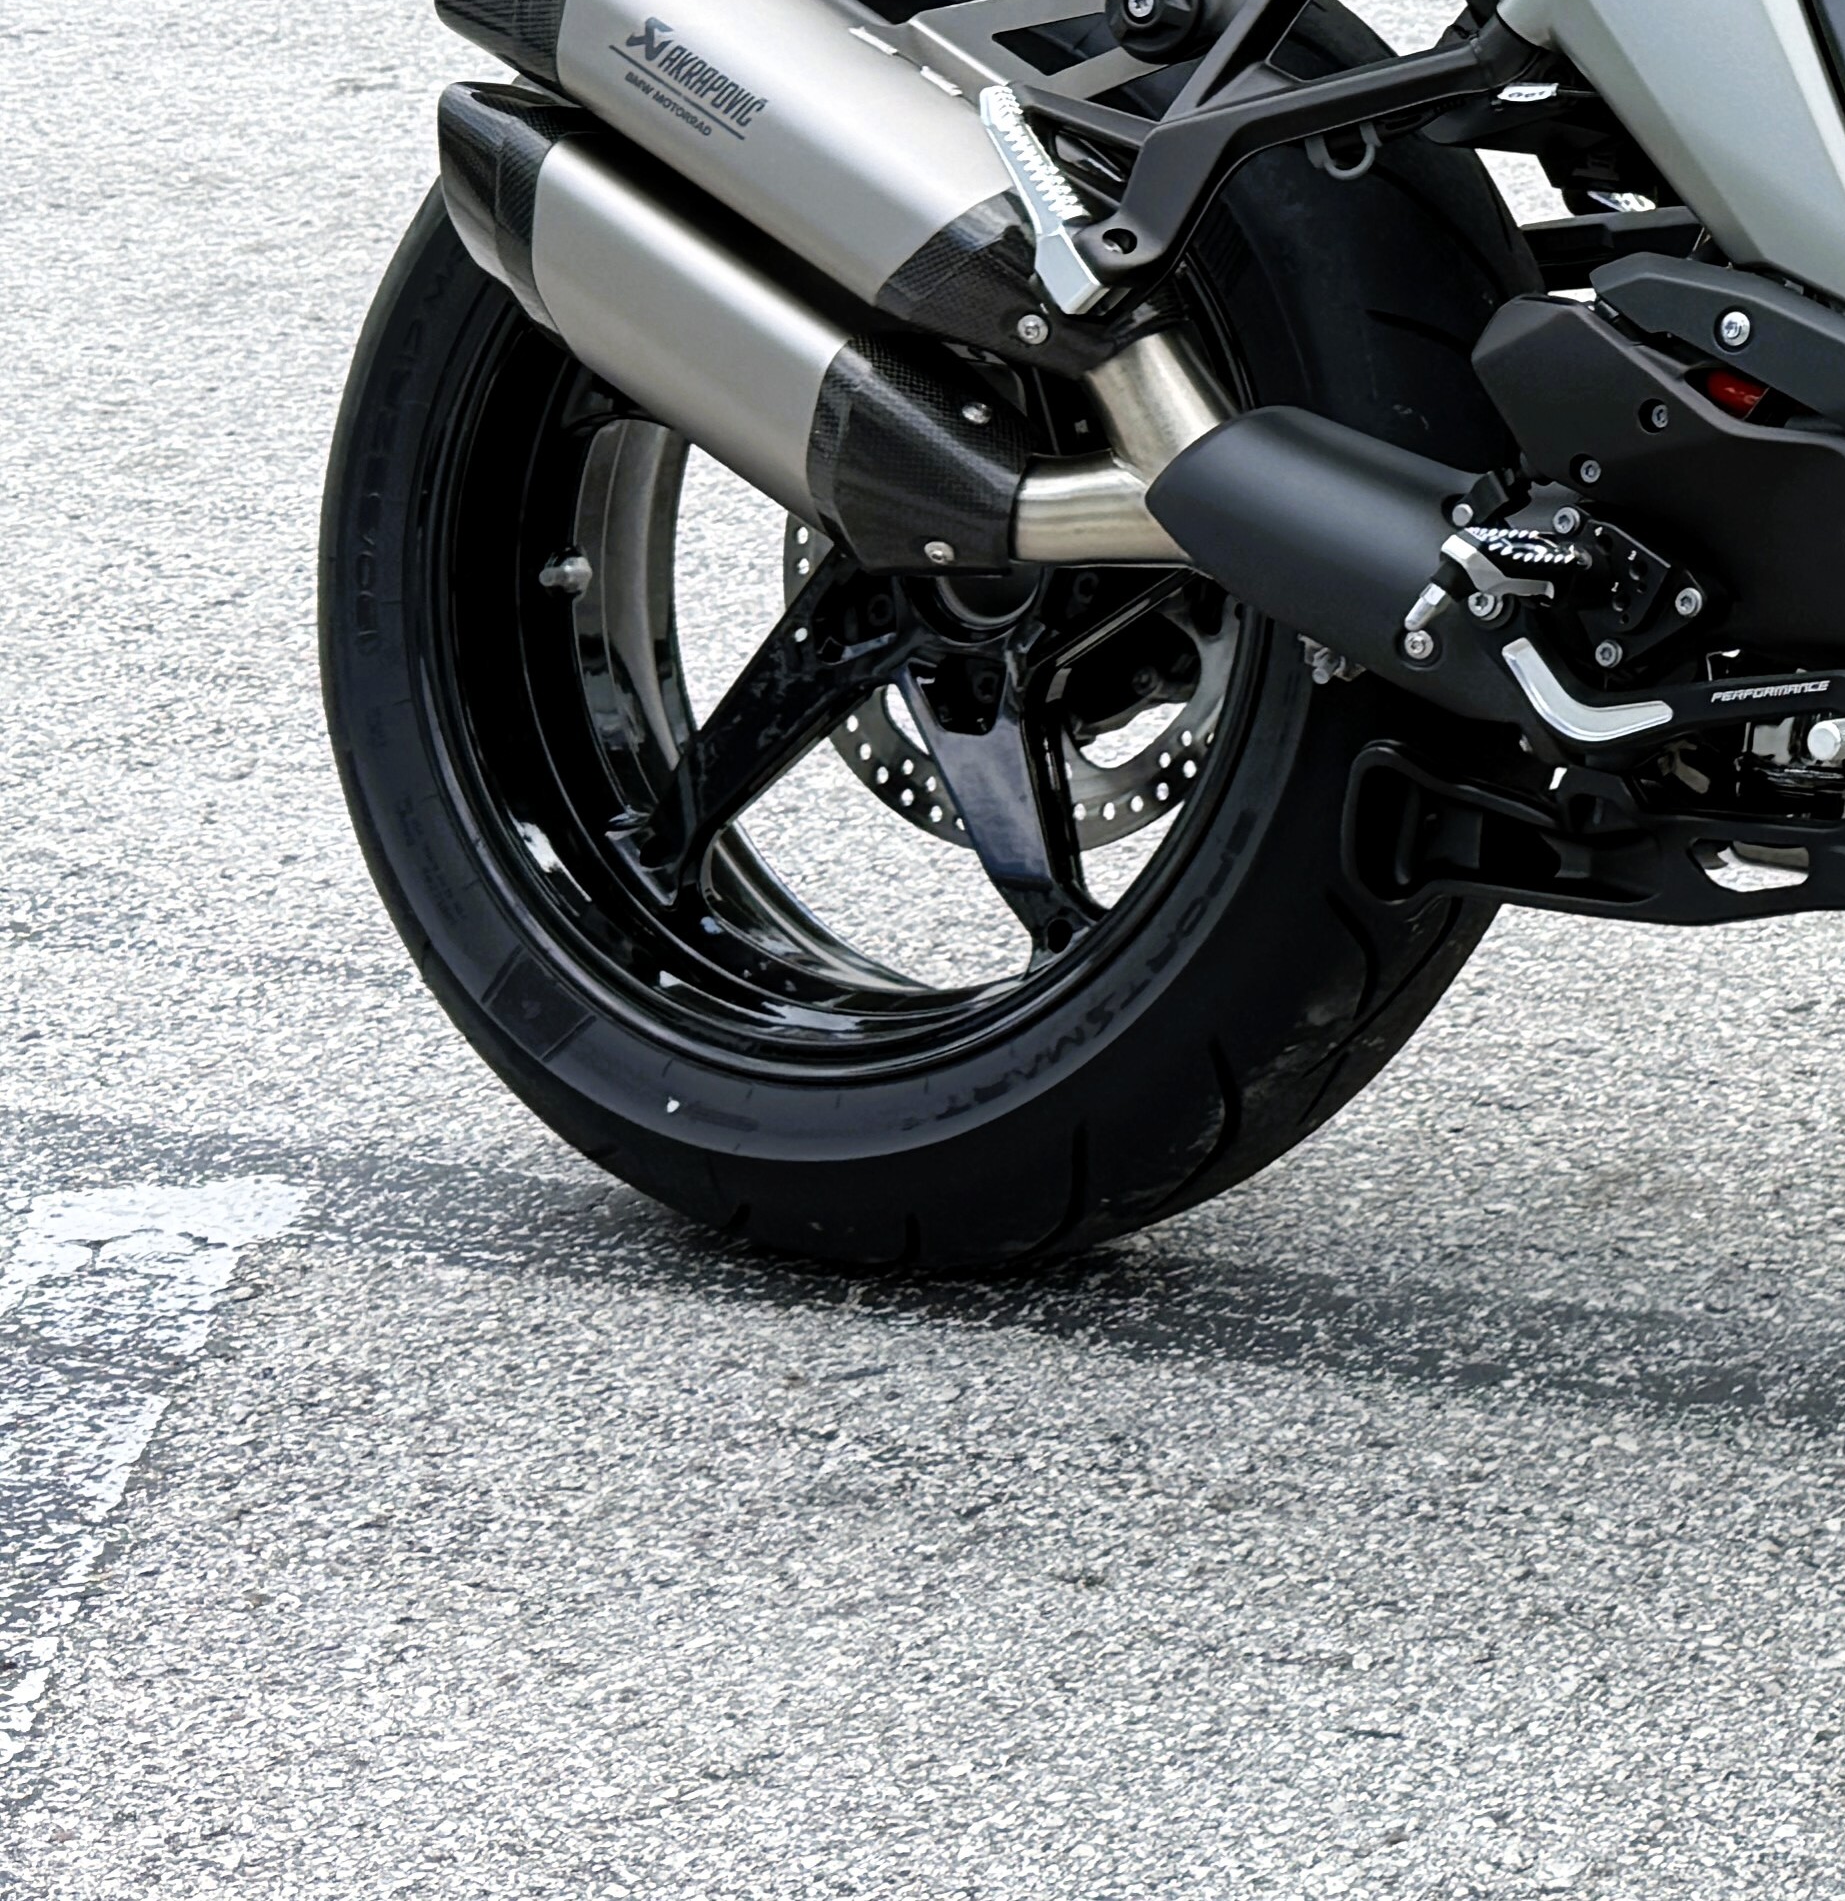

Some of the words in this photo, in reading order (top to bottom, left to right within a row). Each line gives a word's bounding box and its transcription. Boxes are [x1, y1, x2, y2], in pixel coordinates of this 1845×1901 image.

[624, 71, 655, 96] BMW
[652, 89, 713, 137] MOTORRAD
[1710, 679, 1832, 704] PERFORMANCE
